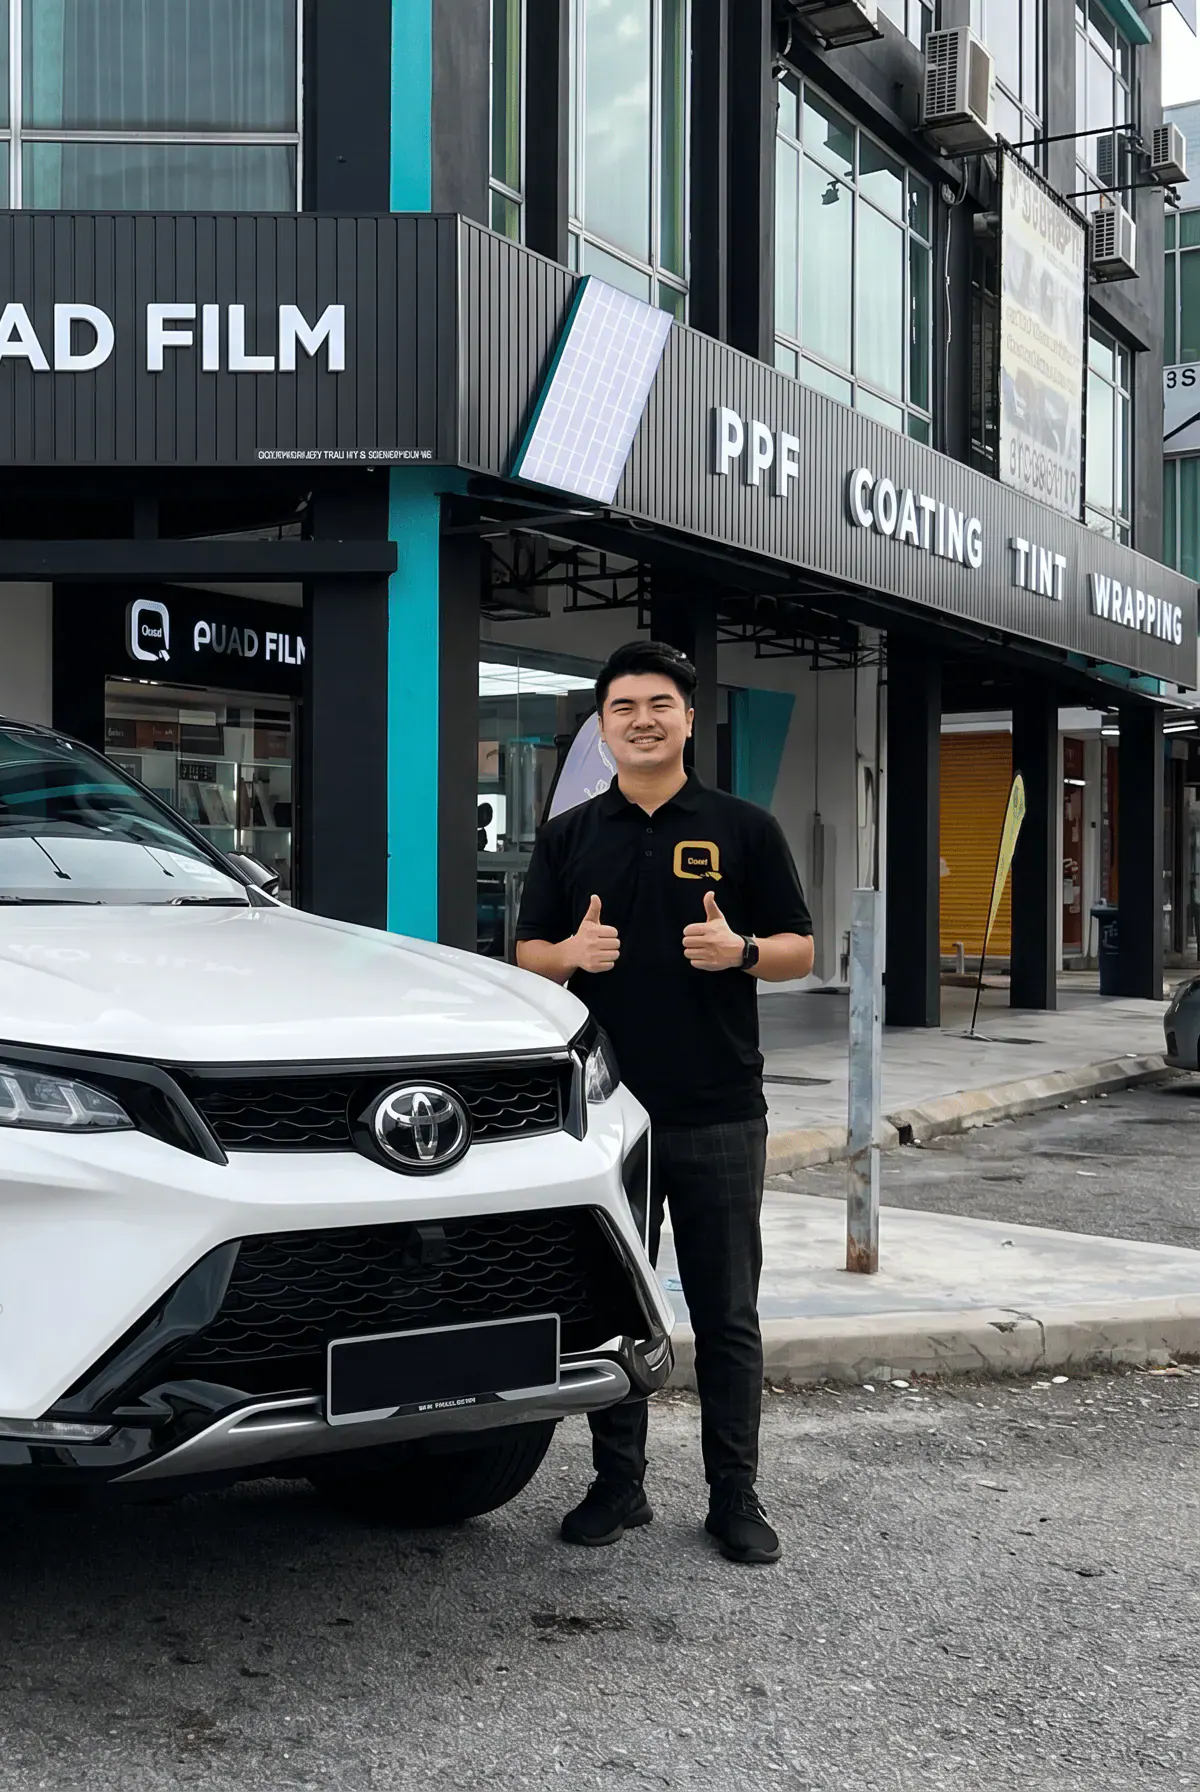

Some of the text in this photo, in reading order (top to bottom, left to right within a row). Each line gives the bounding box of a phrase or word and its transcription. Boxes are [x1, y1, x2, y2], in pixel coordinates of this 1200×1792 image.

[146, 302, 347, 373] FILM
[714, 405, 801, 498] PPF
[849, 467, 983, 569] COATING
[1007, 536, 1068, 602] TINT
[1089, 571, 1183, 646] WRAPPING
